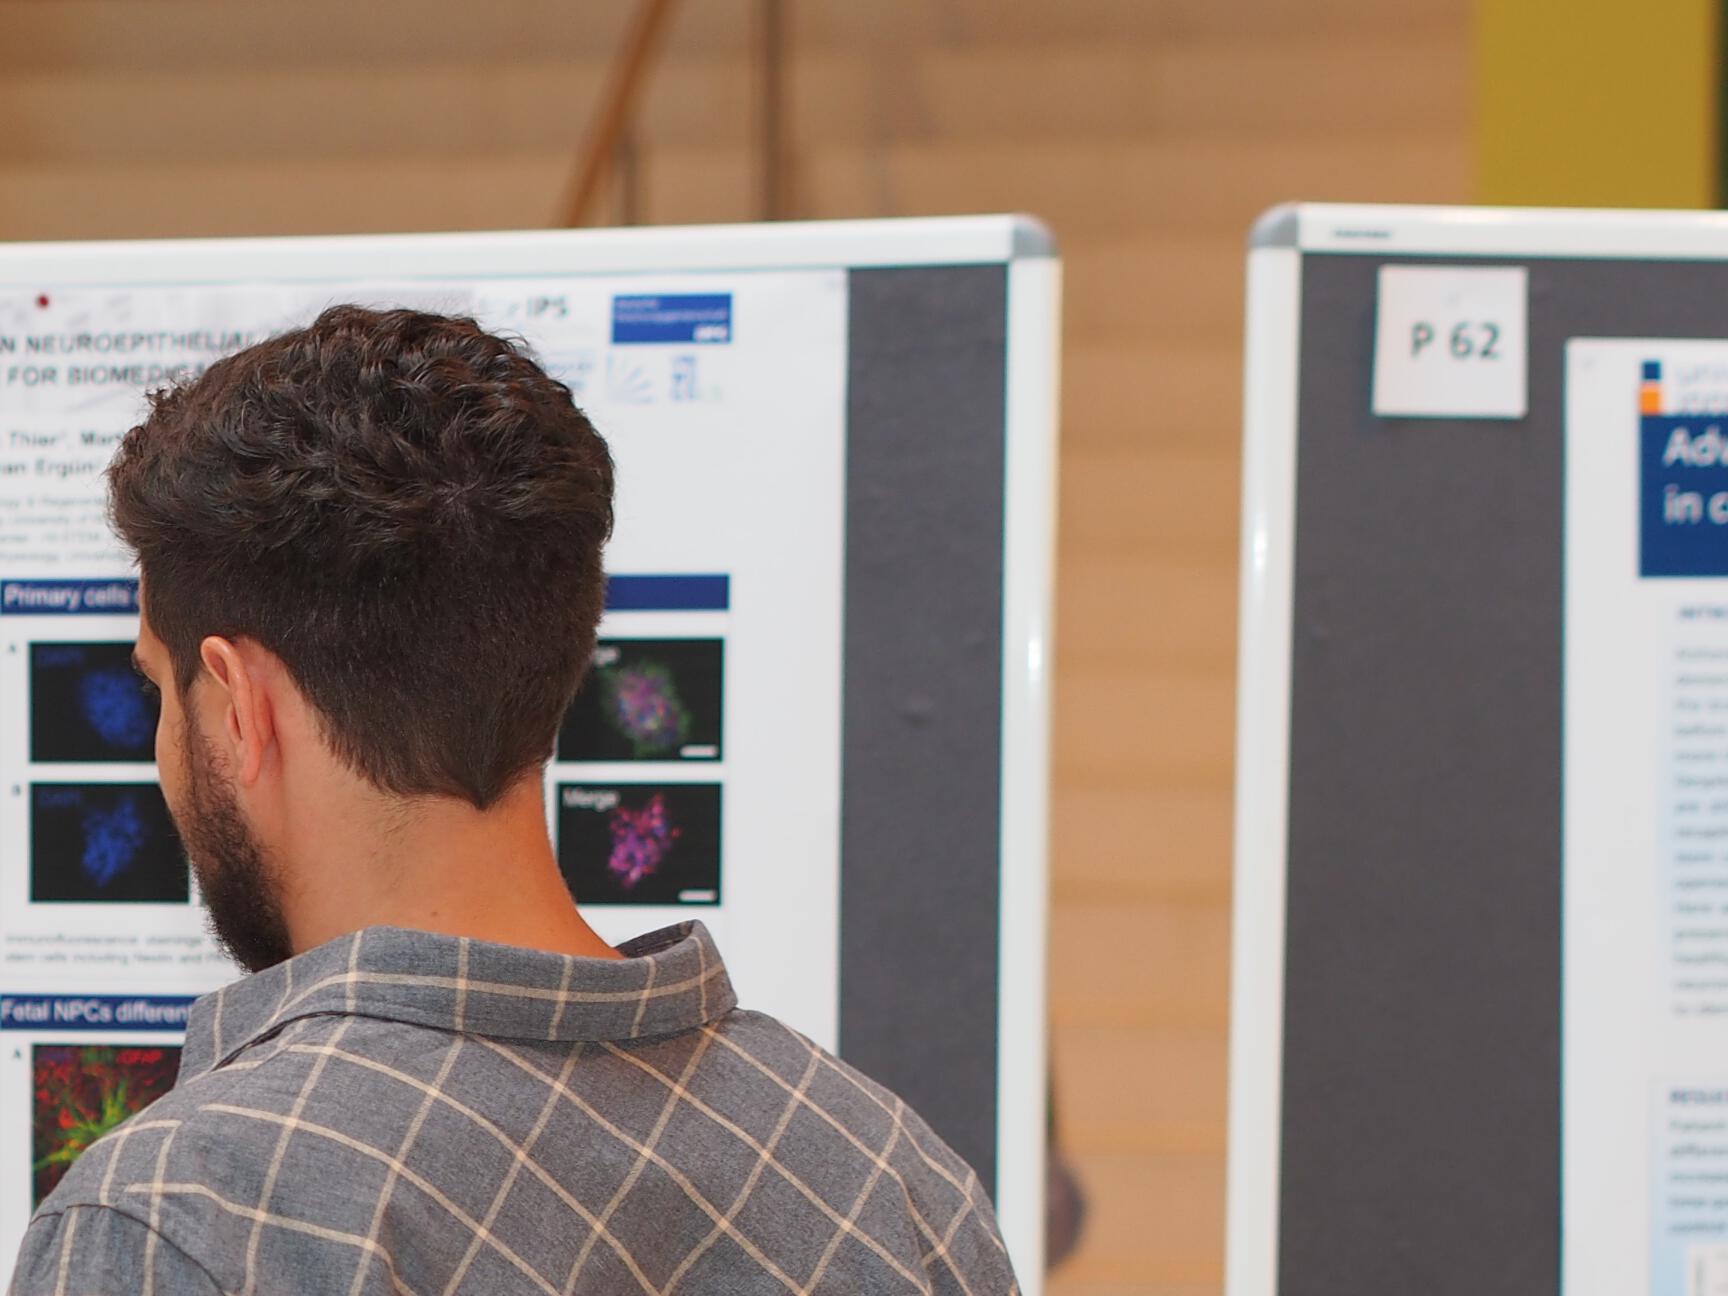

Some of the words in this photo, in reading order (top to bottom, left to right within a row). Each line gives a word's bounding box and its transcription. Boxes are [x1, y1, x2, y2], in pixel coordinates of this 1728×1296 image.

[1411, 322, 1434, 357] P
[1450, 323, 1501, 360] 62
[7, 366, 57, 386] FOR
[1663, 483, 1703, 525] in
[3, 583, 80, 612] Primary
[85, 583, 129, 607] cells
[1, 1000, 48, 1022] Fetal
[54, 1000, 112, 1023] NPCs
